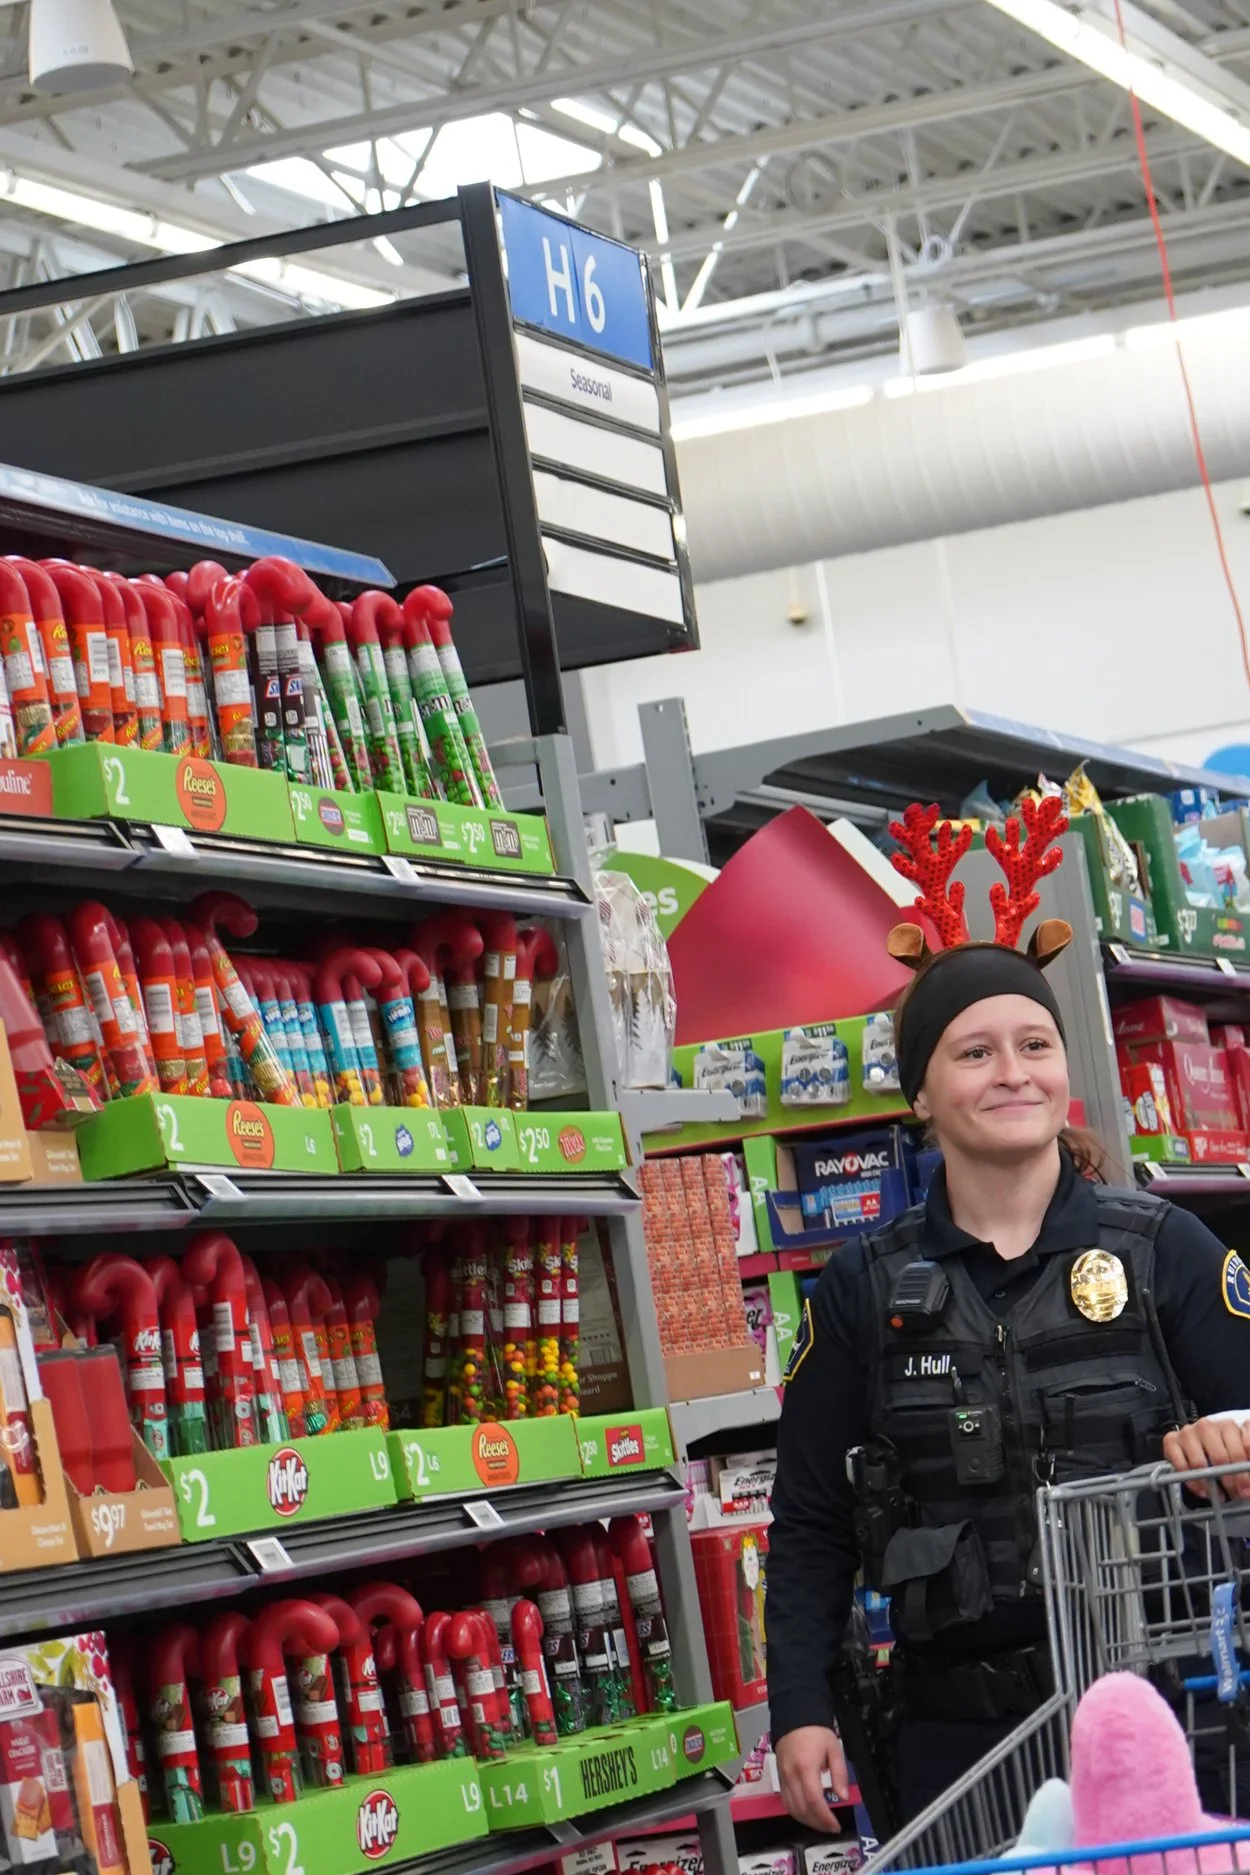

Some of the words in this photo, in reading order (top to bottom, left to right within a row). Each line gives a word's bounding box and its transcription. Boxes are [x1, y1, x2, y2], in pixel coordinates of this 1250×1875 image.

[570, 368, 613, 402] Seasonal
[104, 756, 130, 806] $2
[183, 766, 217, 796] Reese's
[157, 1104, 184, 1152] $2
[233, 1110, 264, 1138] Reese's
[359, 1123, 377, 1157] $2
[472, 1122, 484, 1148] $2
[815, 1151, 890, 1177] RAYOVAC
[904, 1355, 917, 1377] J.
[921, 1355, 951, 1375] Hull
[478, 1431, 510, 1459] Reese's
[611, 1437, 639, 1463] Skittles
[369, 1450, 389, 1481] L9
[406, 1442, 431, 1487] $2
[180, 1468, 217, 1528] $2
[1216, 1625, 1234, 1694] Walmart
[543, 1765, 563, 1809] $1
[580, 1745, 639, 1800] HERSHEY'S
[461, 1782, 481, 1813] L9
[489, 1782, 528, 1809] L14
[359, 1798, 399, 1851] KitKat
[220, 1841, 257, 1874] L9
